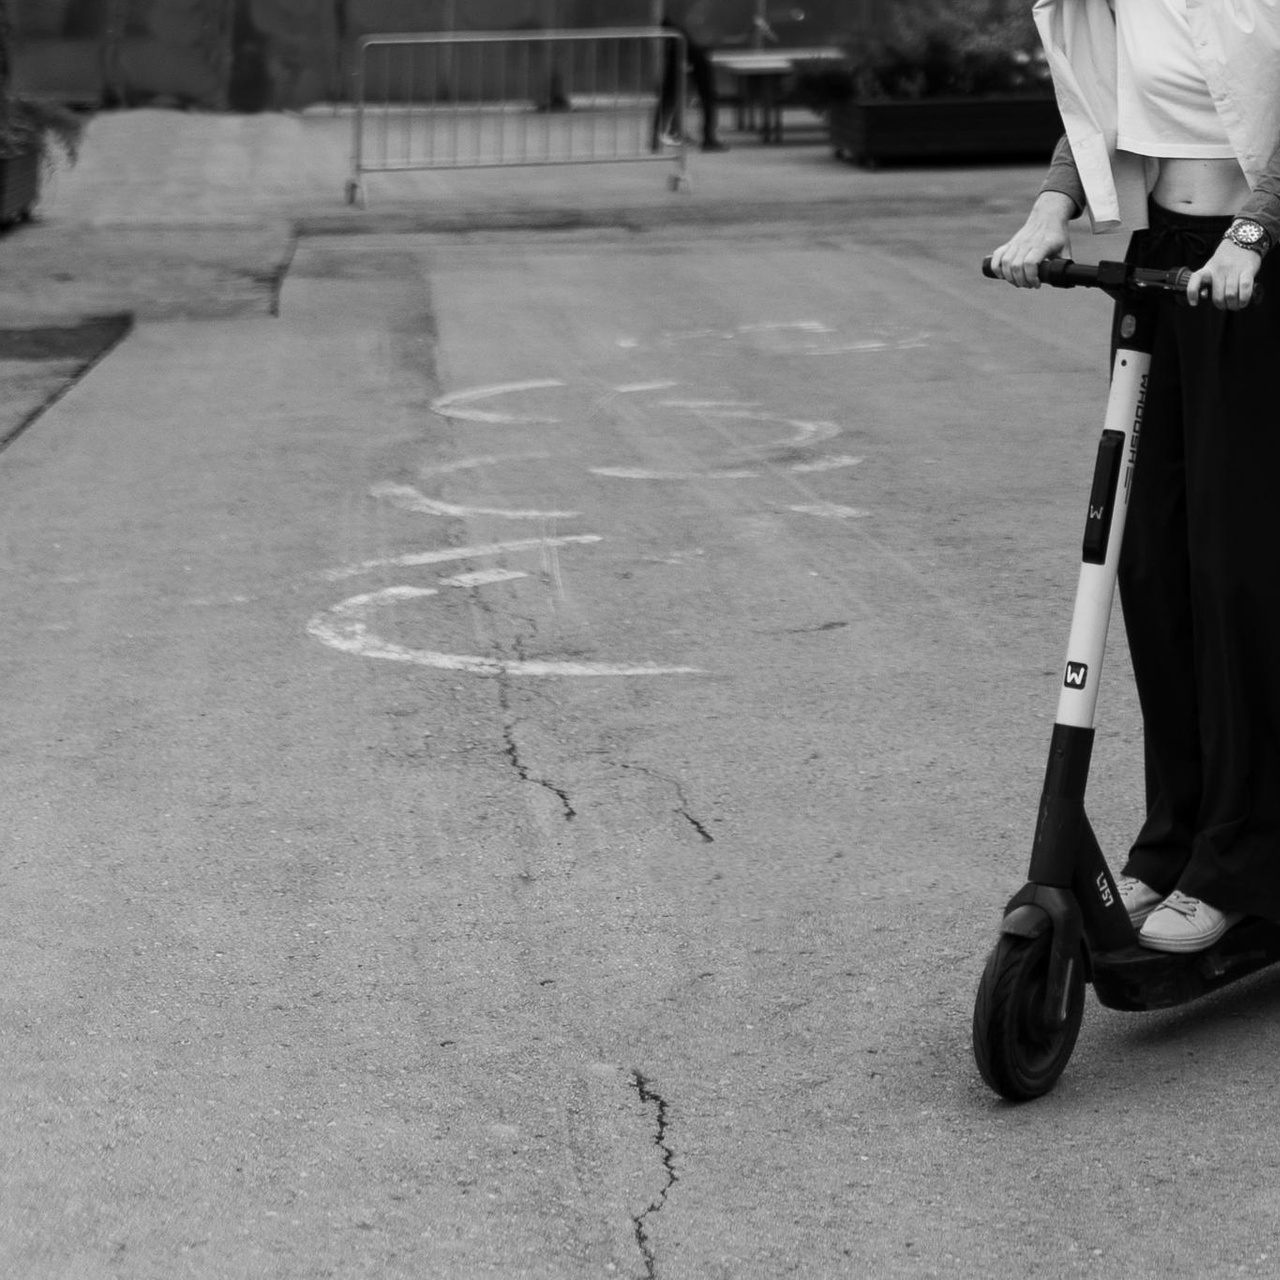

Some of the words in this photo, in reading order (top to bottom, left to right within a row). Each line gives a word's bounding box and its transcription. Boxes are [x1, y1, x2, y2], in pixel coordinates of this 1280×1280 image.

[1128, 374, 1149, 464] WHOOSH
[1090, 505, 1103, 519] W
[1067, 665, 1085, 685] W
